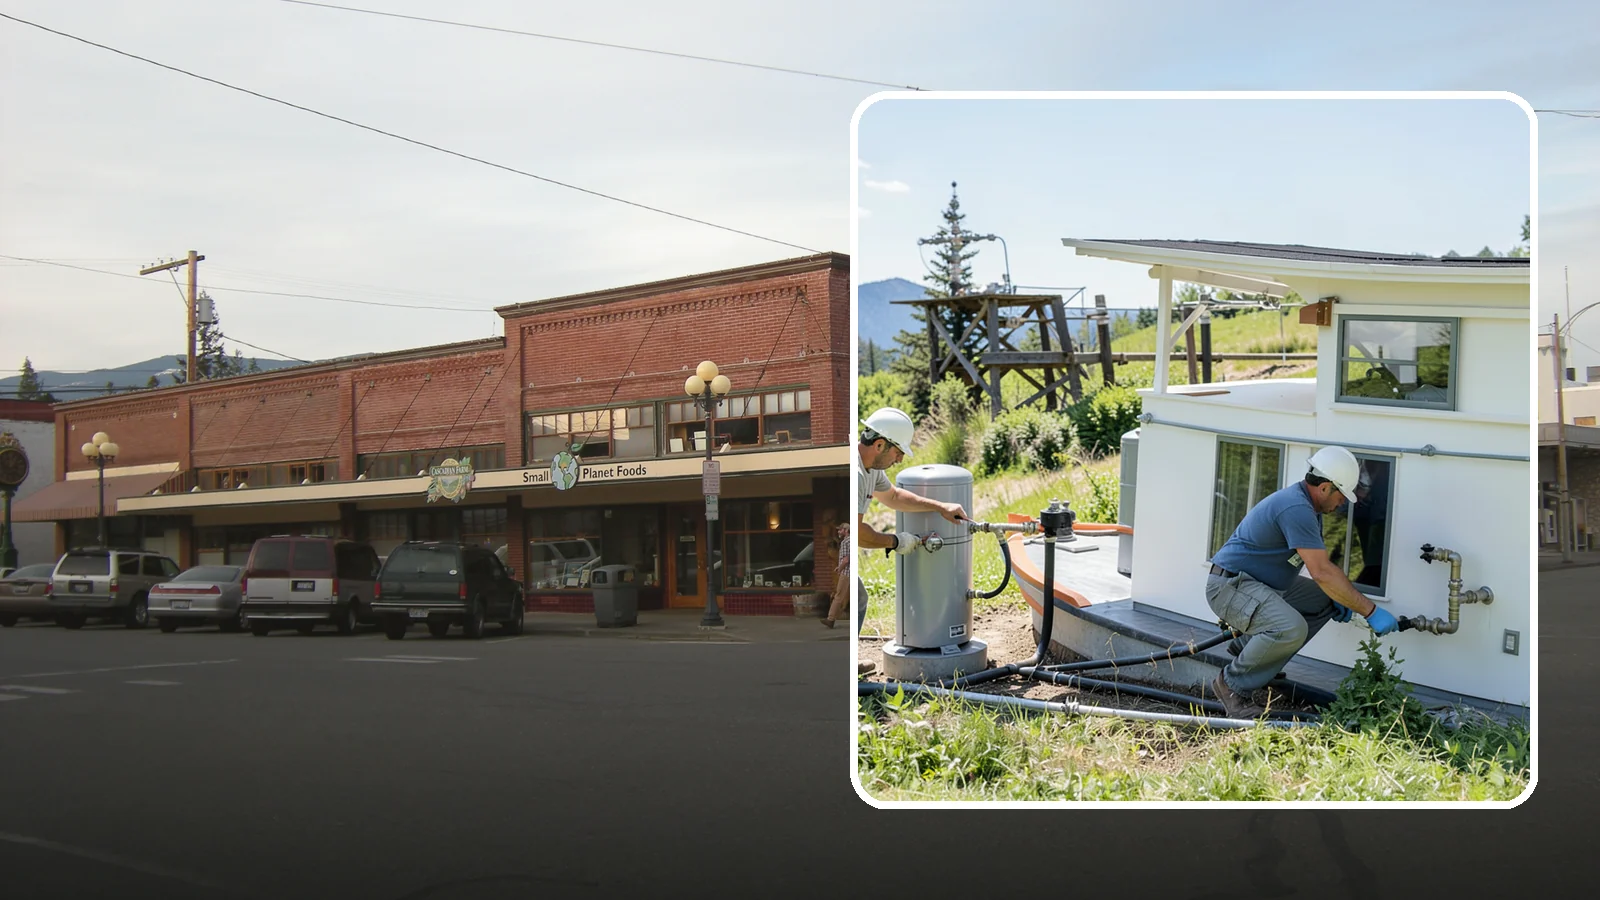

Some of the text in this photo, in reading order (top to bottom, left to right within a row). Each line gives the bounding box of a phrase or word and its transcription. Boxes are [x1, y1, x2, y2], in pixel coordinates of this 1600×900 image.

[523, 464, 647, 482] Small Planet Foods
